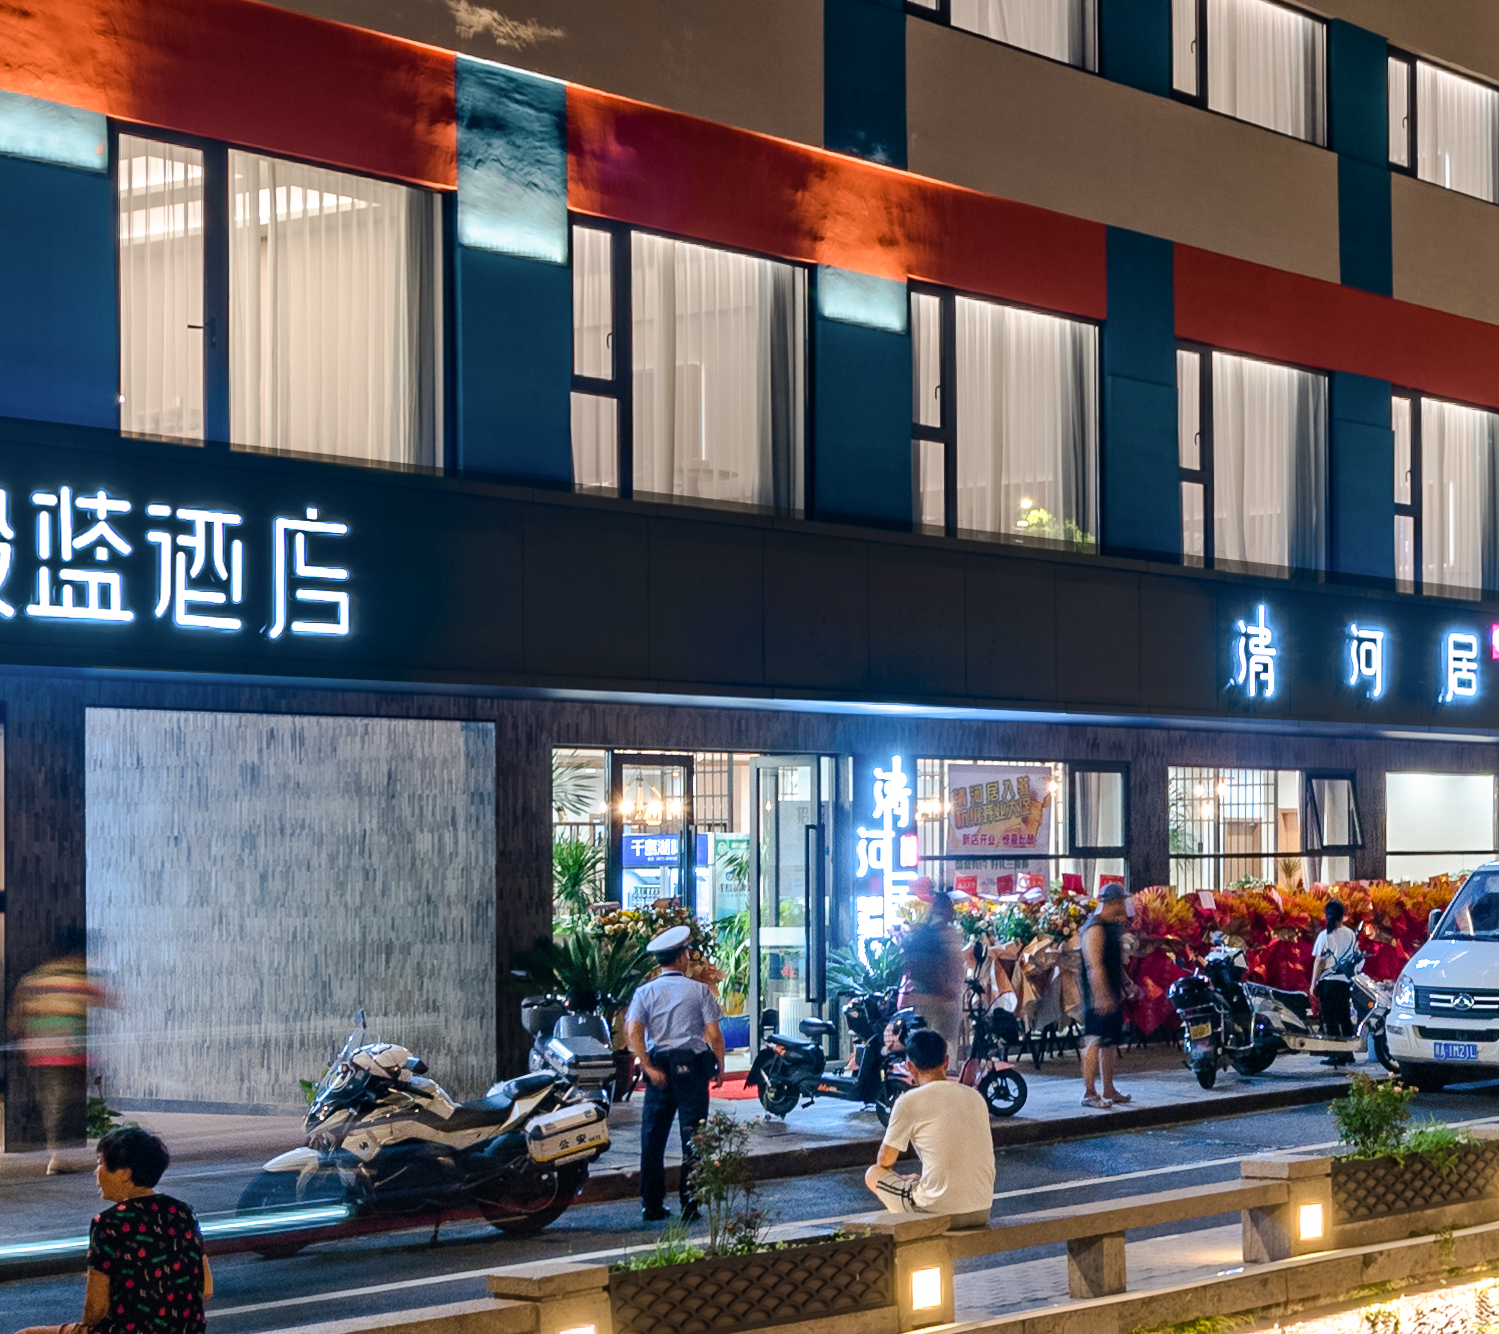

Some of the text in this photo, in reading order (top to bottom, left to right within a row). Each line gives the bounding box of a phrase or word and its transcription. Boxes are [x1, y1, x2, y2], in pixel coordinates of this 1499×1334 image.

[1238, 604, 1478, 702] 清河居
[559, 1133, 587, 1150] 公安
